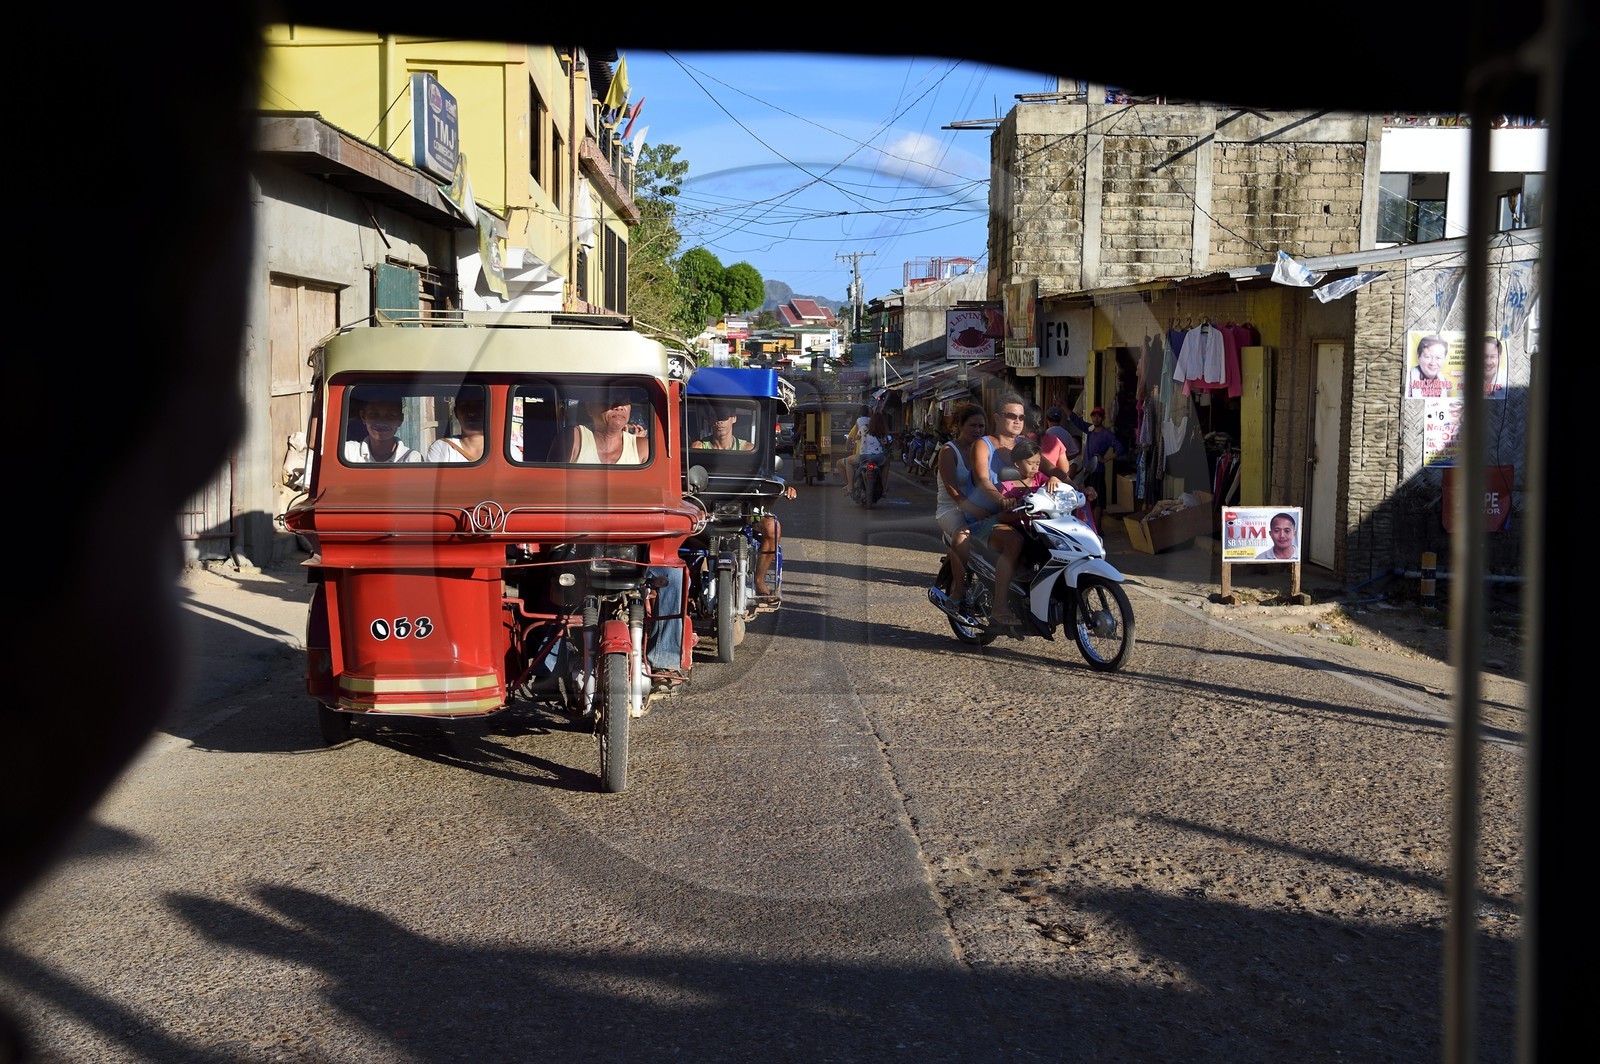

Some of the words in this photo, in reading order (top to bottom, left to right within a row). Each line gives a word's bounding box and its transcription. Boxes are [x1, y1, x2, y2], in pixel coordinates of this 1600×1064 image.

[432, 113, 455, 150] TMJ
[950, 313, 982, 326] LEVIN
[951, 342, 992, 355] RESTAURANT
[1434, 380, 1452, 389] REYES
[1484, 492, 1499, 507] PE
[1228, 526, 1266, 539] LIM
[370, 616, 434, 641] 053
